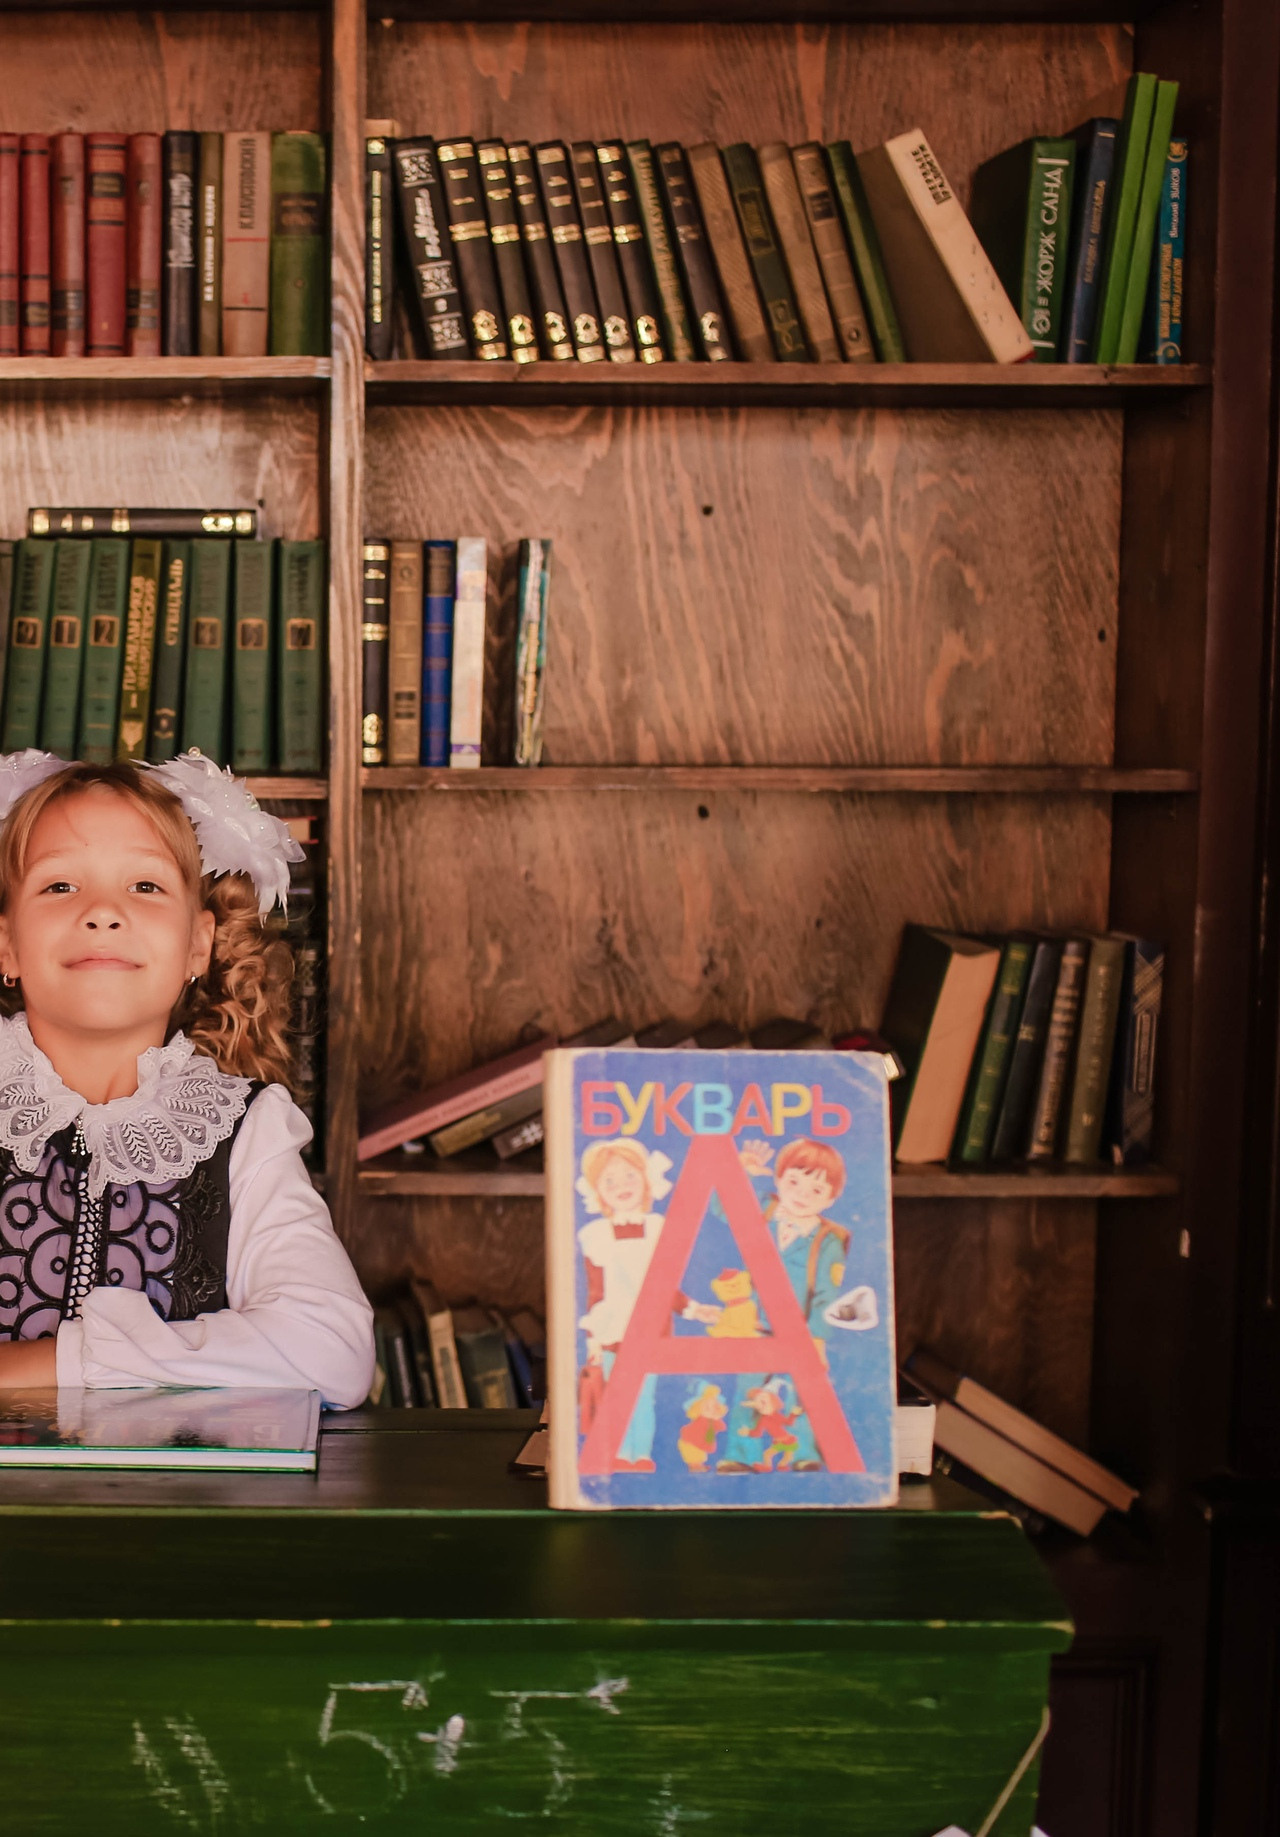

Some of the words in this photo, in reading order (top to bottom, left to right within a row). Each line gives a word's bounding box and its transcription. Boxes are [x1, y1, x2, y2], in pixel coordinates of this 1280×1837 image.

[1040, 167, 1064, 226] САНД
[1036, 231, 1057, 294] ЖОРЖ
[580, 1081, 852, 1138] БУКВАРЬ
